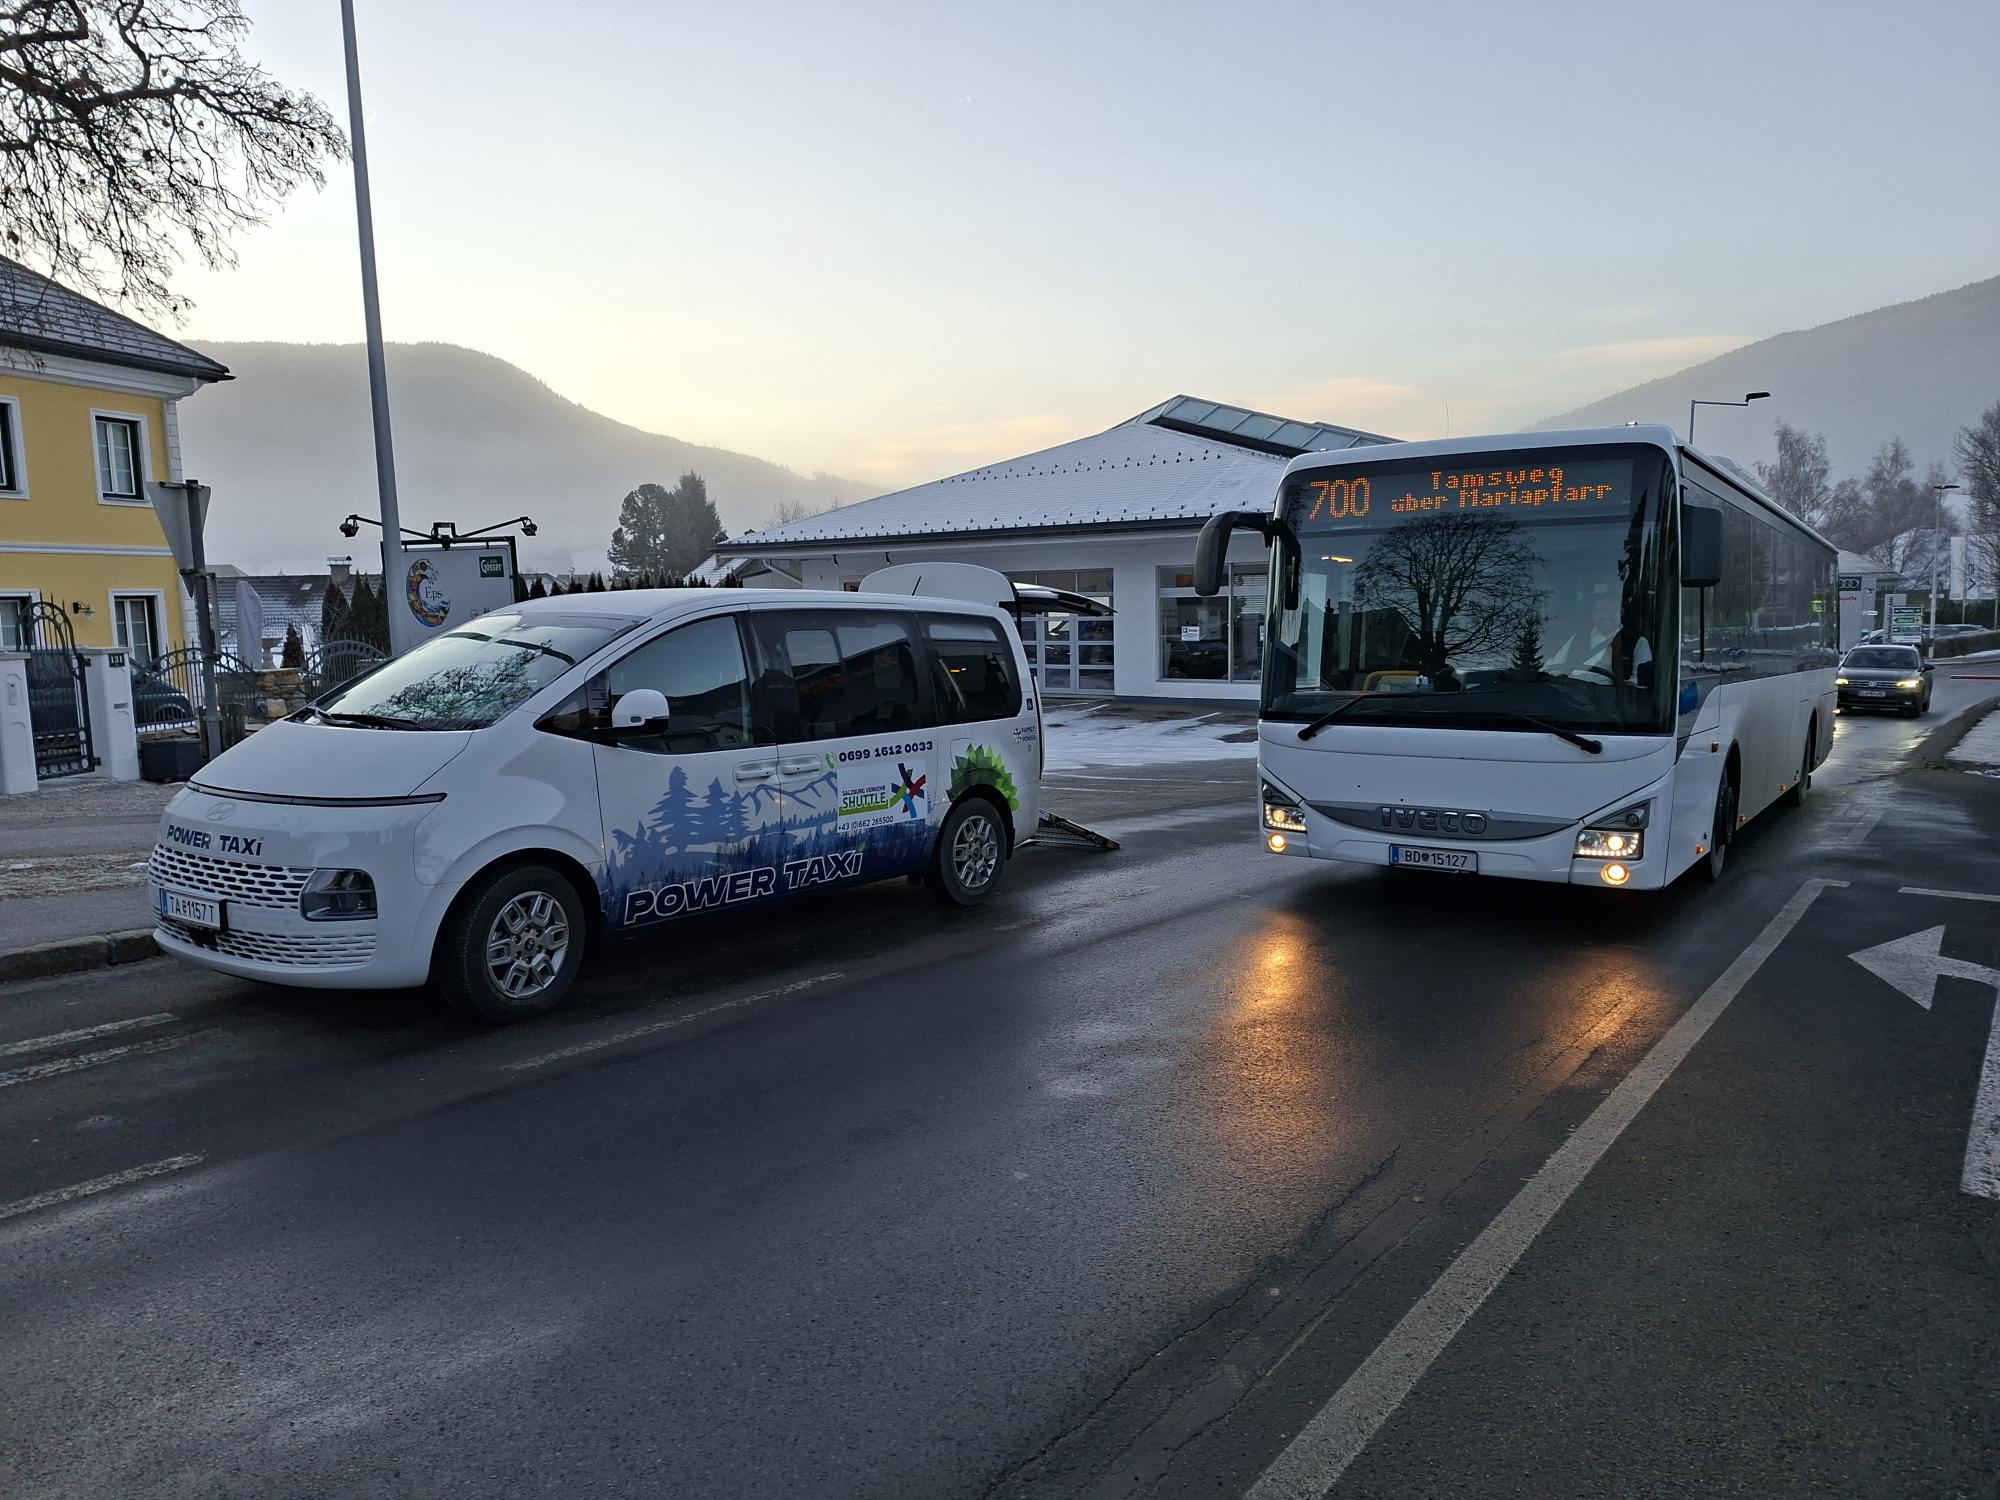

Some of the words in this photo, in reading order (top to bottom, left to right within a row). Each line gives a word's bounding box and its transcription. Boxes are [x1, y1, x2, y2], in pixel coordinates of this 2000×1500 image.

[1431, 468, 1563, 490] Tamsweg
[1310, 477, 1372, 520] 700
[1458, 482, 1613, 508] Mariapfarr
[425, 586, 443, 600] Eps
[111, 655, 123, 664] 131
[839, 749, 870, 762] 0699
[874, 745, 902, 758] 1612
[904, 741, 933, 754] 0033
[842, 788, 865, 796] SALZBURG
[842, 792, 886, 809] SHUTTLE
[1381, 807, 1487, 834] IVECO
[166, 824, 212, 850] POWER
[1404, 850, 1421, 863] BD
[1430, 853, 1468, 868] 15127
[169, 895, 181, 915] TA
[624, 867, 776, 925] POWER
